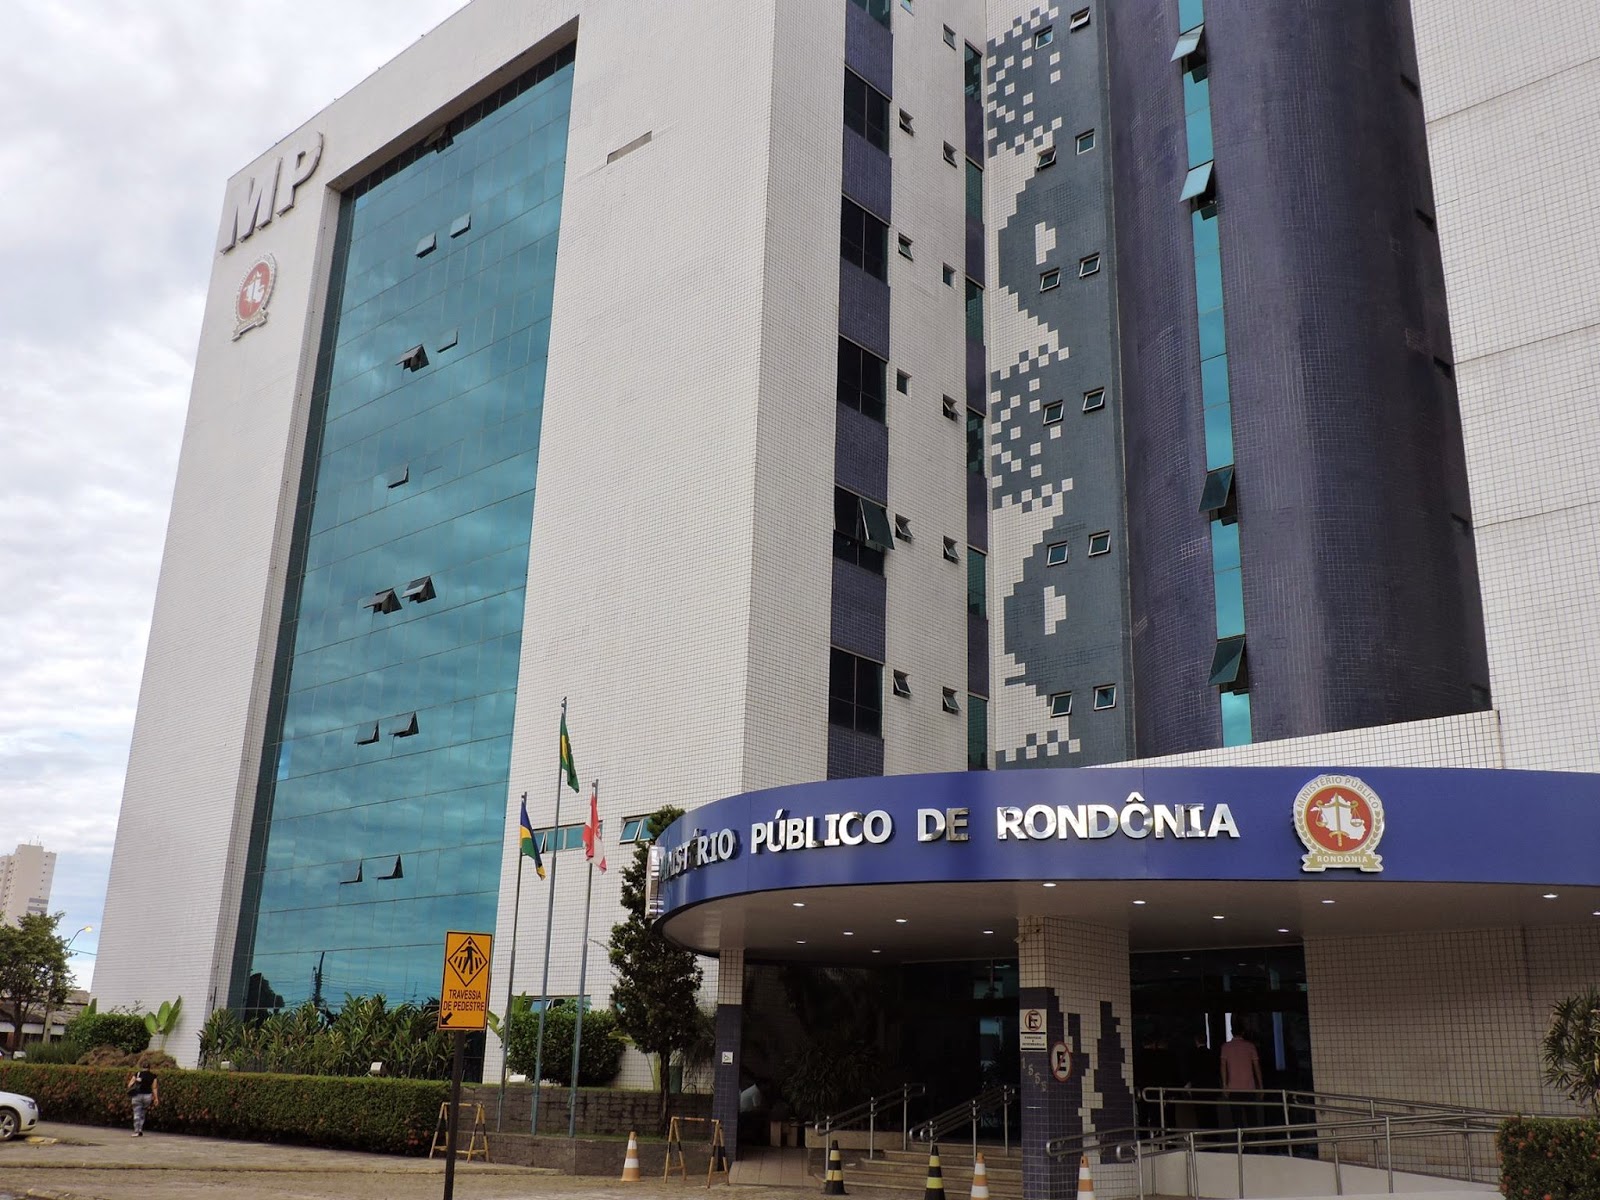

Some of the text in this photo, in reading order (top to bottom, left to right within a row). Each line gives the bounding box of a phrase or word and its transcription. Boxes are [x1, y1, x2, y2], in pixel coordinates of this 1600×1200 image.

[220, 131, 324, 255] MP
[1297, 776, 1379, 809] MINISTÉRIO PÚBLICO
[750, 808, 893, 854] PÚBLICO
[917, 808, 969, 842] DE
[996, 791, 1241, 840] RONDÔNIA
[1316, 853, 1369, 864] RONDÔNIA
[449, 989, 482, 1000] TRAVESSIA
[443, 1001, 485, 1012] DE PEDESTRE
